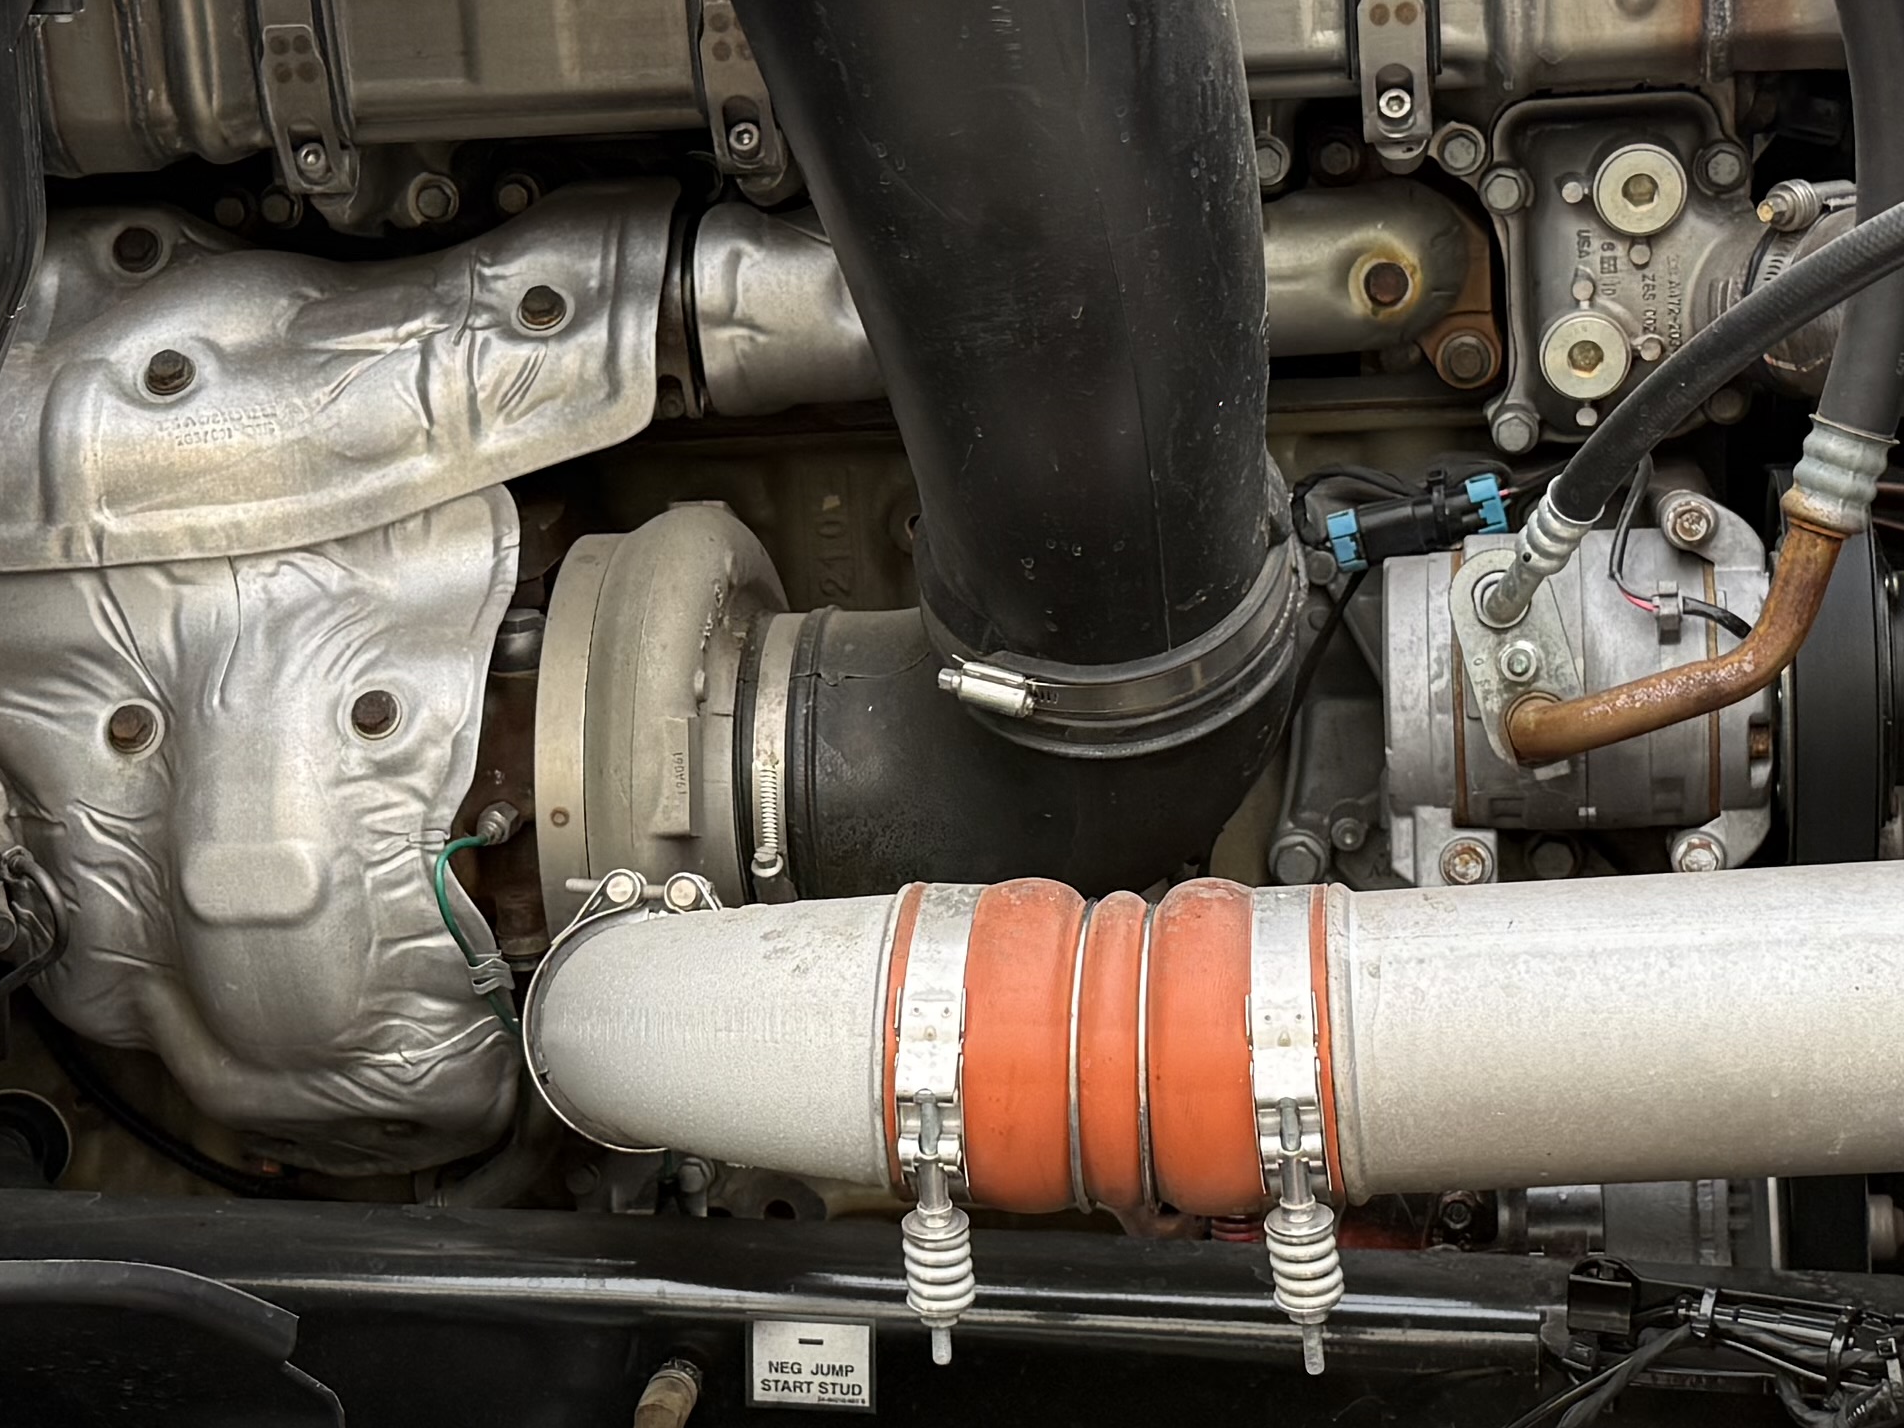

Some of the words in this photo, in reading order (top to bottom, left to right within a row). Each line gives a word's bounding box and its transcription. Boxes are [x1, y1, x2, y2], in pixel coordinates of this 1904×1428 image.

[1577, 229, 1592, 259] USA
[768, 1360, 802, 1374] NEG
[810, 1363, 854, 1377] JUMP
[760, 1378, 814, 1393] START
[817, 1381, 862, 1396] STUD
